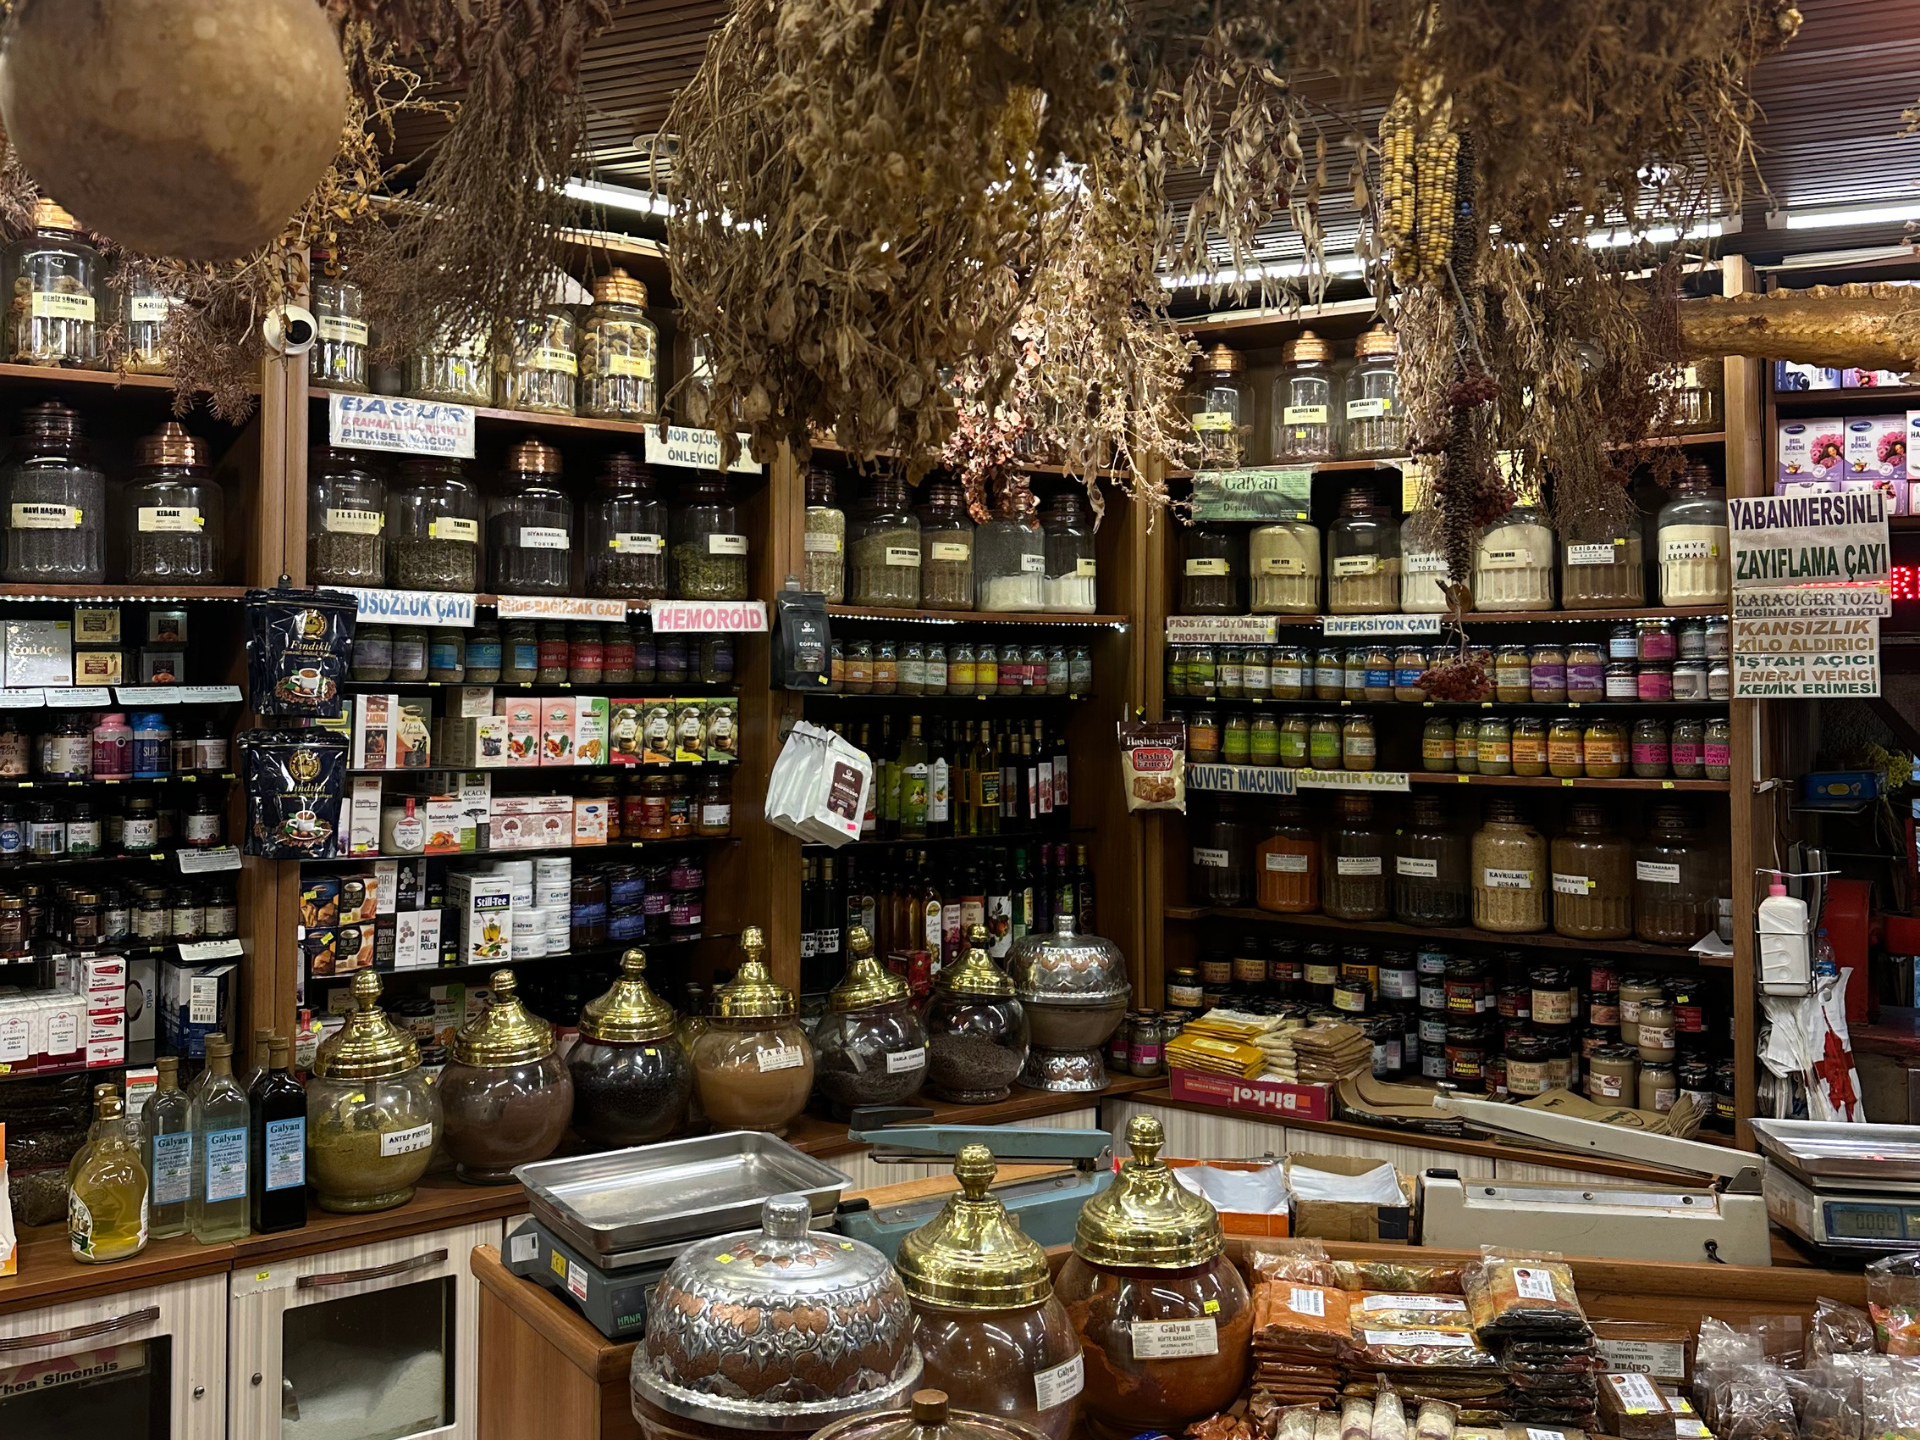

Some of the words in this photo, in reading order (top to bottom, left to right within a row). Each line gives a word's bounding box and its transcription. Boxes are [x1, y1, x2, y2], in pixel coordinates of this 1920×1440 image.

[340, 396, 466, 423] BASUR
[342, 428, 404, 442] BİTKİSEL
[649, 427, 688, 444] TMÖR
[667, 449, 718, 465] ÖNLEYİCİ
[1669, 542, 1706, 550] KAHVE
[1737, 547, 1840, 579] ZAYIFLAMA
[1845, 544, 1887, 582] ÇAYI
[1736, 591, 1836, 607] KARACİĞER
[1840, 592, 1884, 606] TOZU
[436, 598, 471, 623] ÇAYI
[658, 602, 762, 630] HEMOROİD
[1736, 607, 1796, 617] ENGİNAR
[1169, 619, 1213, 629] PROSTAT
[1326, 618, 1404, 632] ENFEKSİYON
[1408, 618, 1437, 633] ÇAYI
[1738, 619, 1871, 636] KANSIZLIK
[1172, 633, 1216, 642] PROSTAT
[1219, 631, 1265, 643] İLTAHABI
[1738, 636, 1783, 651] KİLO
[1789, 637, 1875, 651] ALDIRICI
[289, 638, 331, 652] Fındıklı
[1739, 655, 1805, 669] İŞTAH
[1813, 655, 1875, 668] AÇICI
[1739, 668, 1806, 682] ENERJİ
[1812, 667, 1876, 682] VERİCİ
[1737, 681, 1797, 695] KEMİK
[1802, 680, 1877, 694] ERİMESİ
[1186, 765, 1234, 789] KUVVET
[1238, 769, 1293, 793] MACUNU
[462, 789, 487, 797] ACACIA
[1489, 871, 1529, 882] KAVRULMUŞ
[476, 897, 507, 907] Still-Tee
[420, 934, 431, 942] BAL
[420, 942, 437, 950] POLEN
[1233, 1086, 1297, 1109] Birkol
[270, 1122, 301, 1135] Galyan
[158, 1136, 189, 1148] Galyan
[211, 1133, 243, 1145] Galyan
[389, 1133, 411, 1144] ANTEP
[1160, 1323, 1192, 1334] Galyan
[43, 1360, 119, 1386] Sinensis
[1057, 1364, 1076, 1380] Galyan
[1613, 1361, 1651, 1374] Galyan
